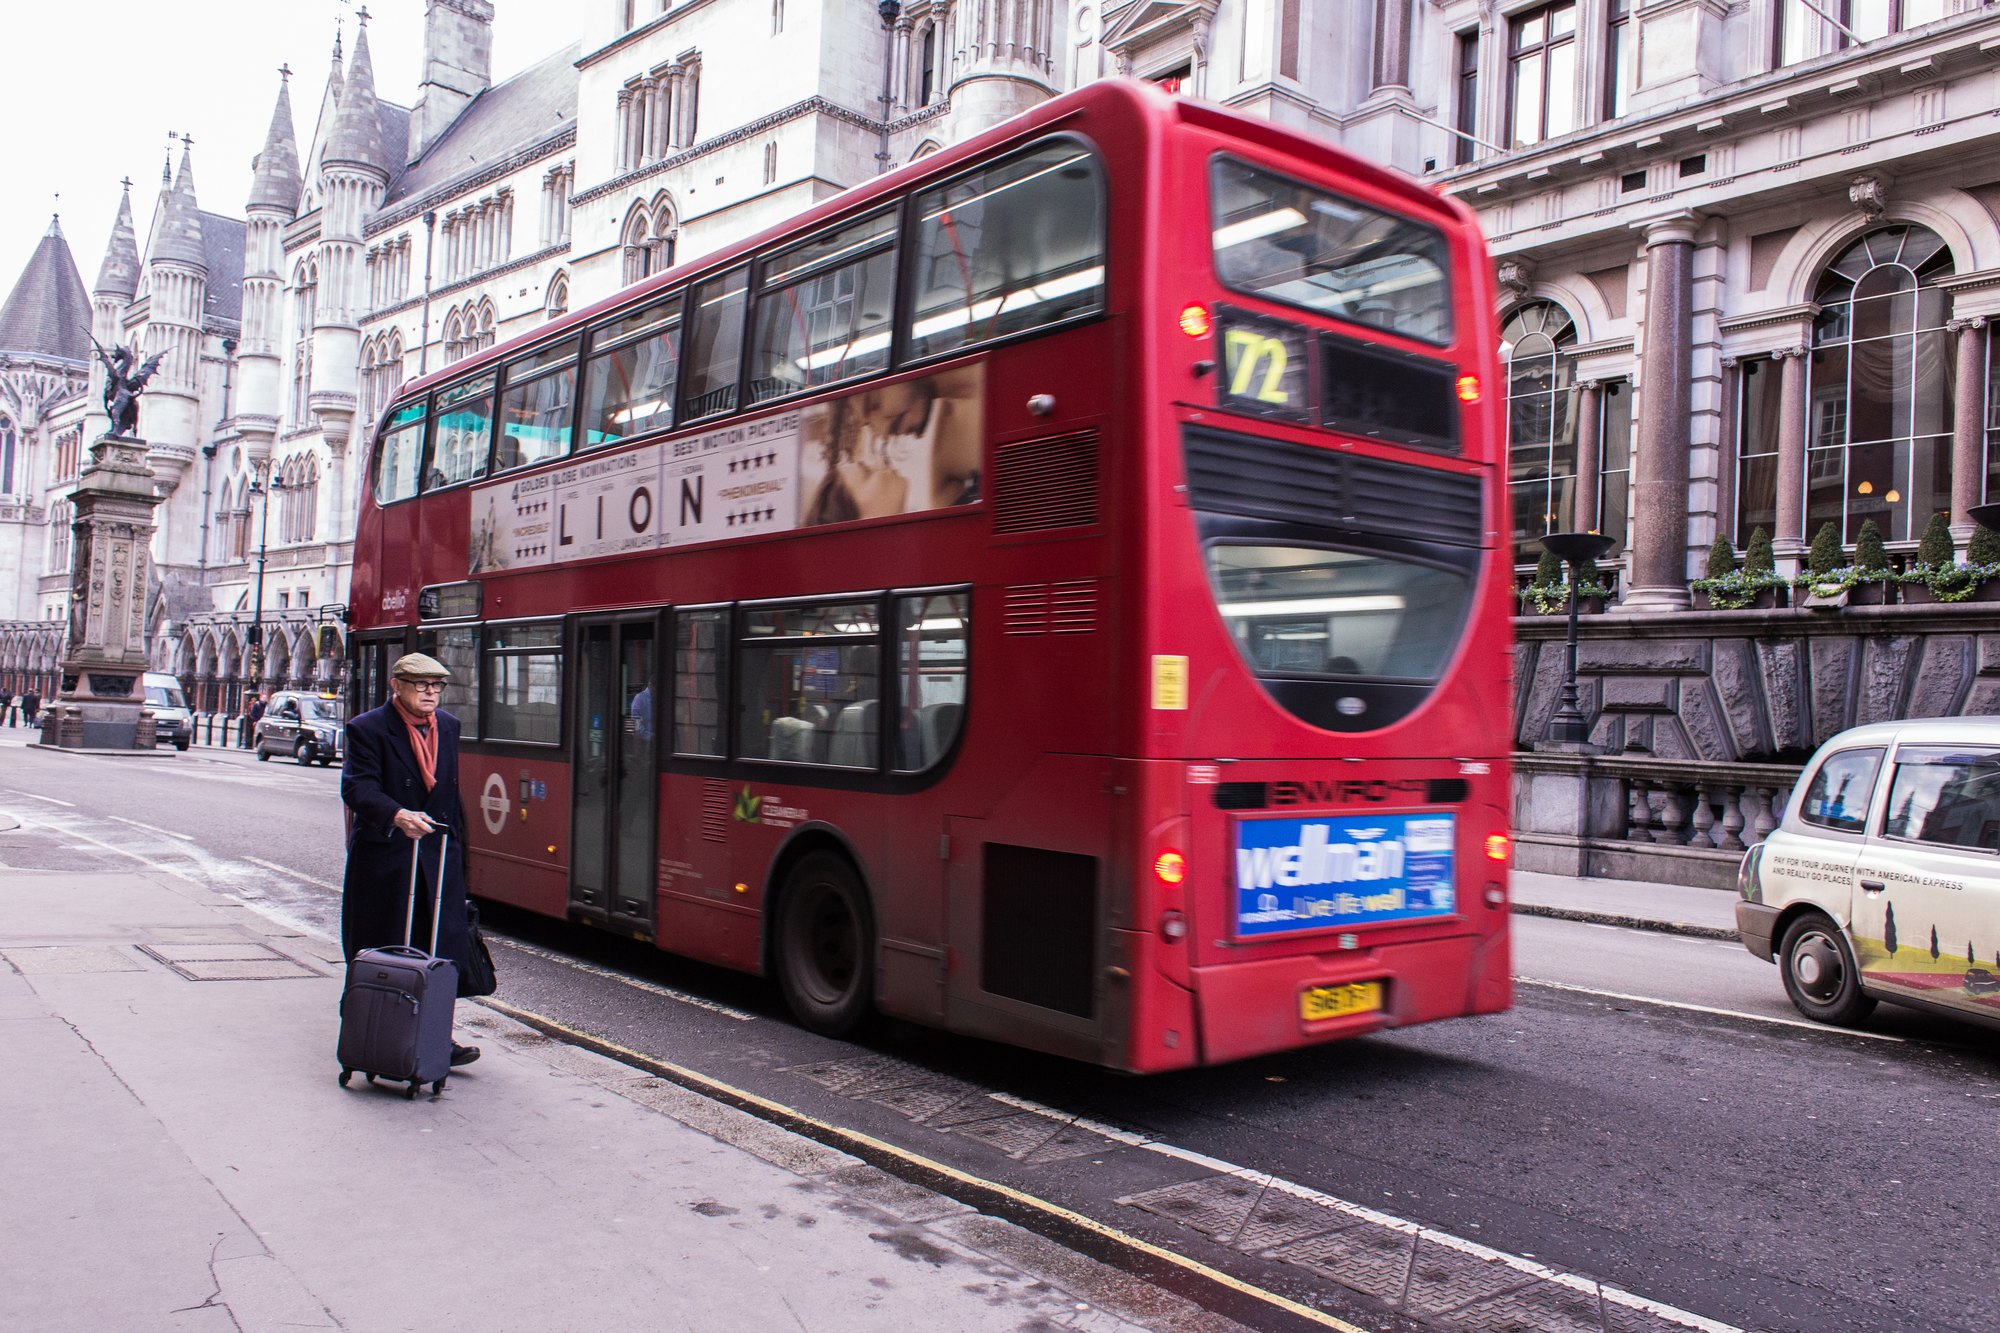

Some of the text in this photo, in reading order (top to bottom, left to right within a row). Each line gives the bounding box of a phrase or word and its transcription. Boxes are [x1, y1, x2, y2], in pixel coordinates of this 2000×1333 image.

[673, 413, 799, 457] BEST MOTION PICTURE
[511, 482, 520, 504] 4
[520, 476, 549, 493] GOLDEN
[551, 469, 577, 486] GLOBE
[580, 454, 638, 479] NOMINATIONS
[560, 475, 703, 546] LION
[1772, 867, 1785, 876] AND
[1786, 868, 1810, 879] REALLY
[1811, 872, 1822, 881] GO
[1773, 856, 1964, 891] PAY FOR YOUR JOURNEY WITH AMERICAN EXPRESS
